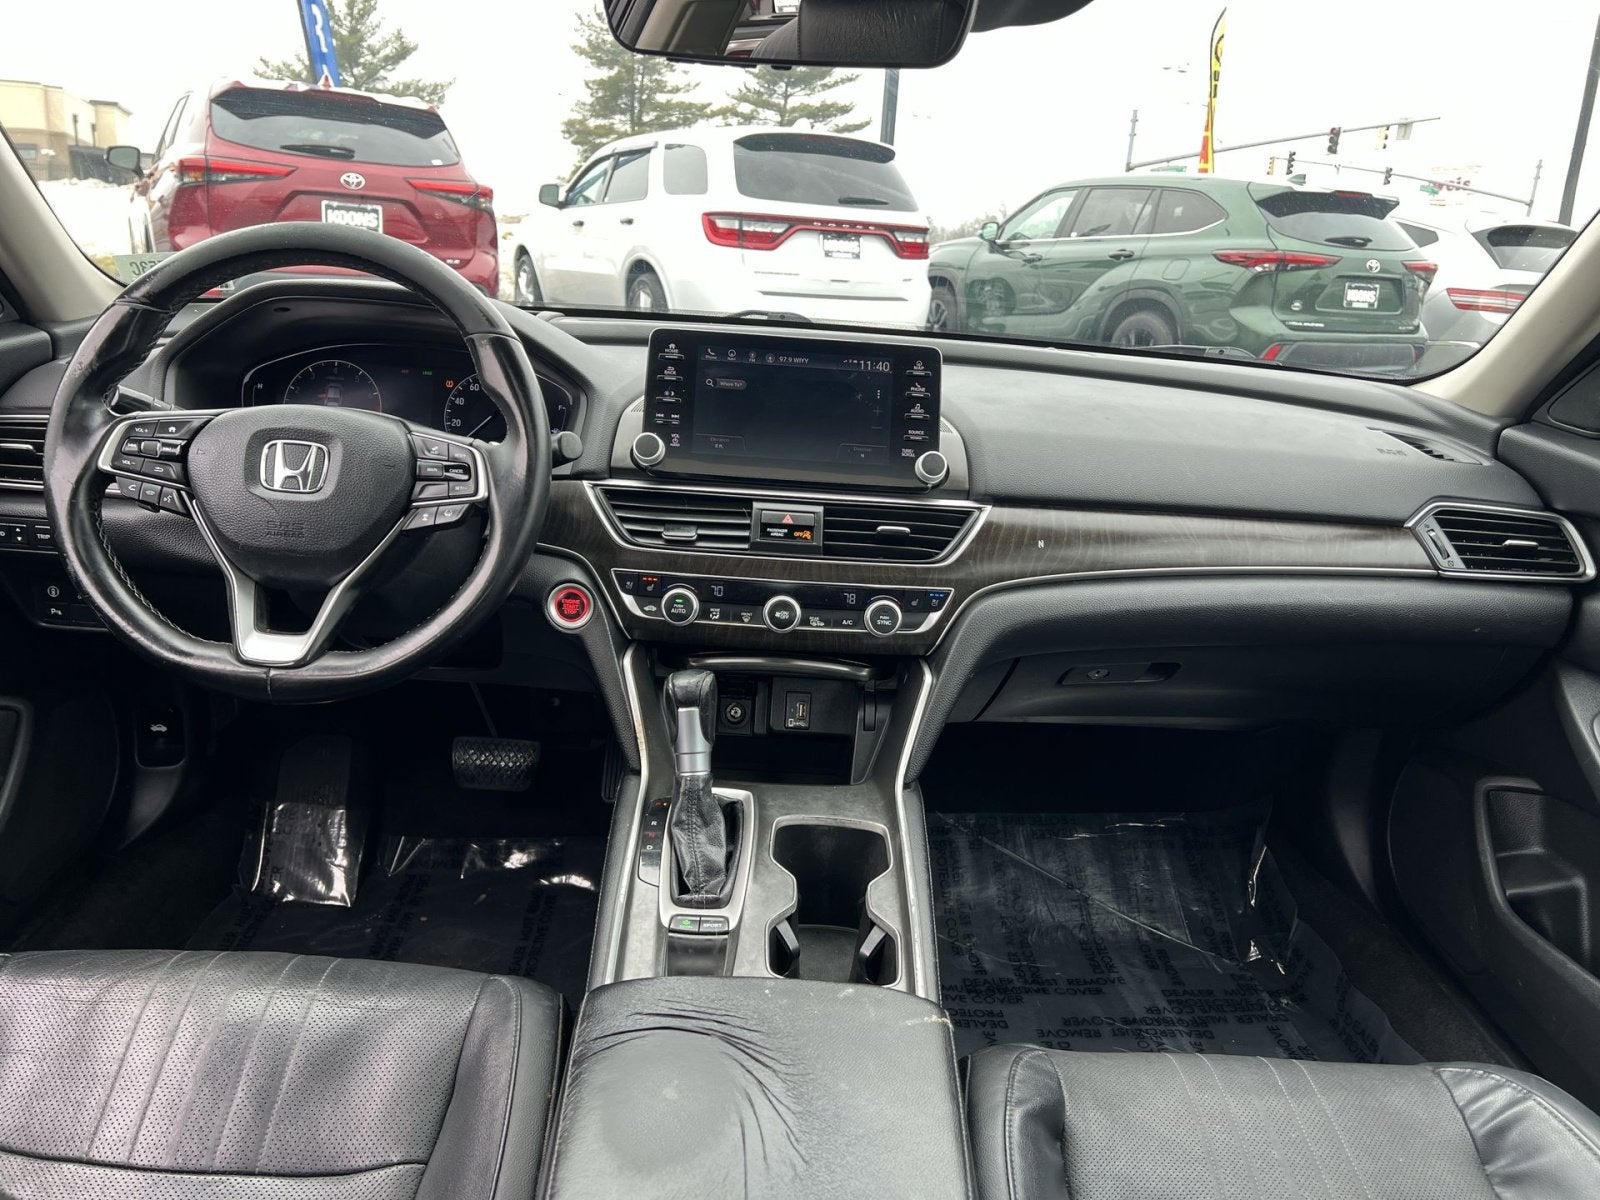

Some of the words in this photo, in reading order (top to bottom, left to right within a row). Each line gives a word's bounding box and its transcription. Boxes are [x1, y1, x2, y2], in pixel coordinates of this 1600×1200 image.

[860, 361, 890, 372] 11:40
[469, 383, 480, 391] 60
[454, 397, 465, 406] 40
[451, 418, 462, 427] 20
[711, 585, 723, 596] 70
[843, 593, 856, 604] 78
[945, 1008, 1005, 1019] PROTEC
